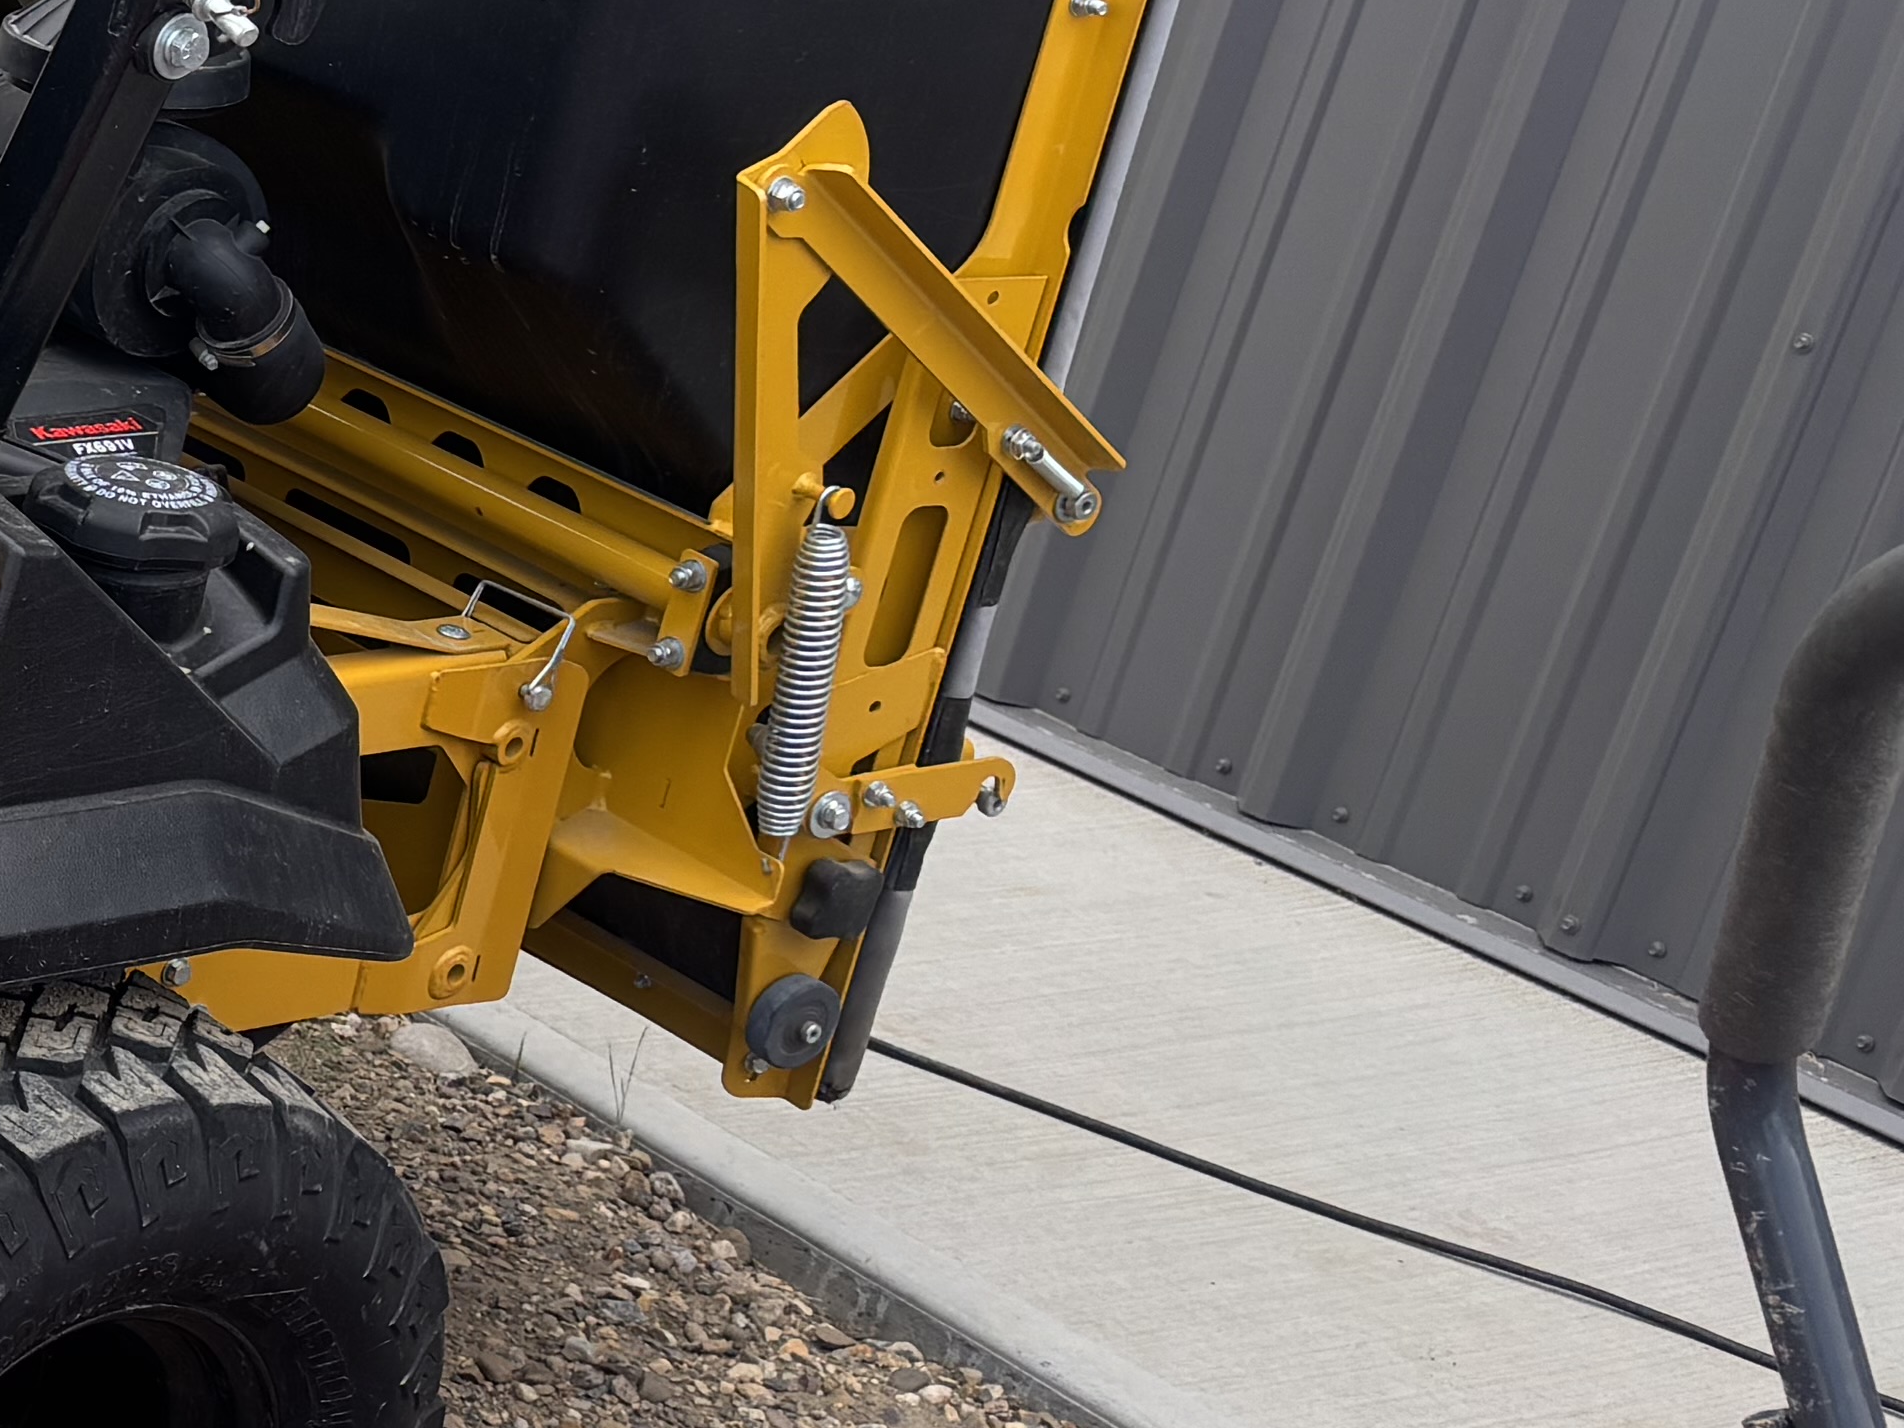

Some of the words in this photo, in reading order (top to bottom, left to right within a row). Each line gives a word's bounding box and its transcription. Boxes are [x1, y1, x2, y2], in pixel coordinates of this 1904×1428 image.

[28, 416, 145, 441] Kawasaki
[95, 487, 117, 500] DO
[117, 494, 149, 507] NOT
